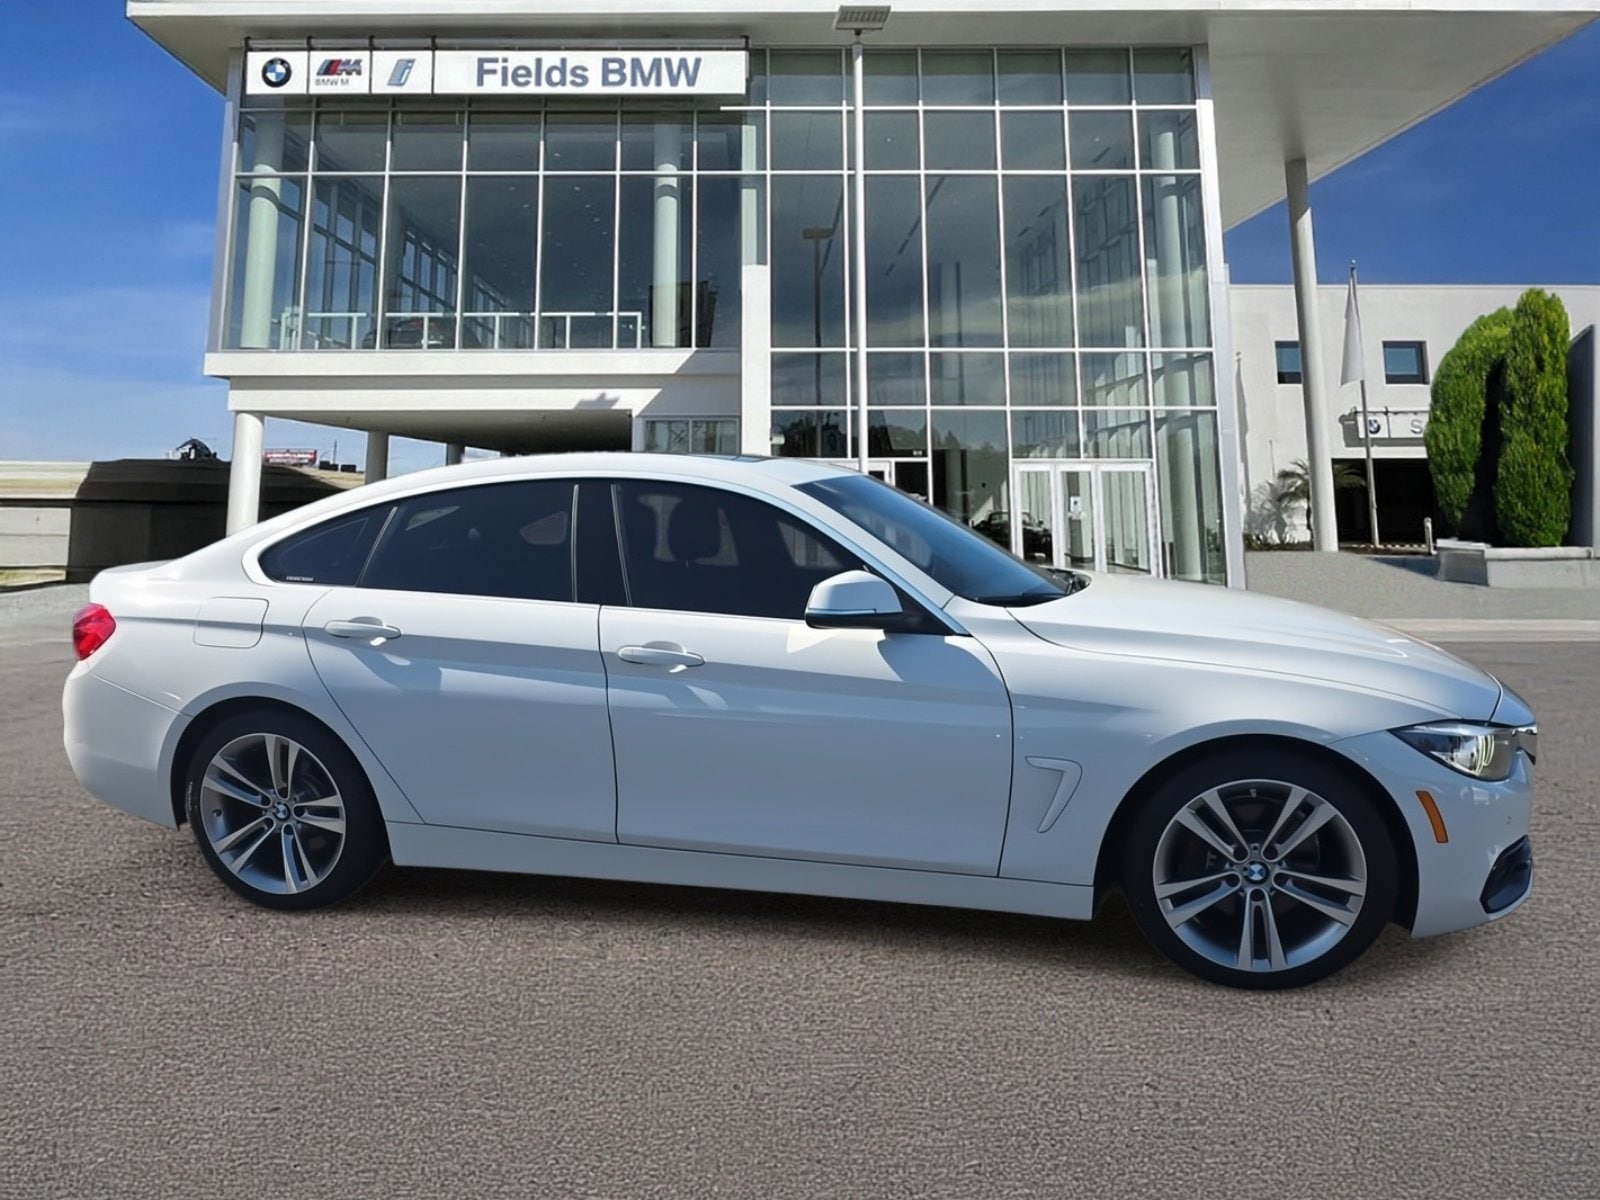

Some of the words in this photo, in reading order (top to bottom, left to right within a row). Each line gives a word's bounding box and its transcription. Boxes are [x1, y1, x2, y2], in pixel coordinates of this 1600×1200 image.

[476, 57, 589, 88] Fields
[601, 57, 702, 87] BMW
[1410, 418, 1423, 434] S
